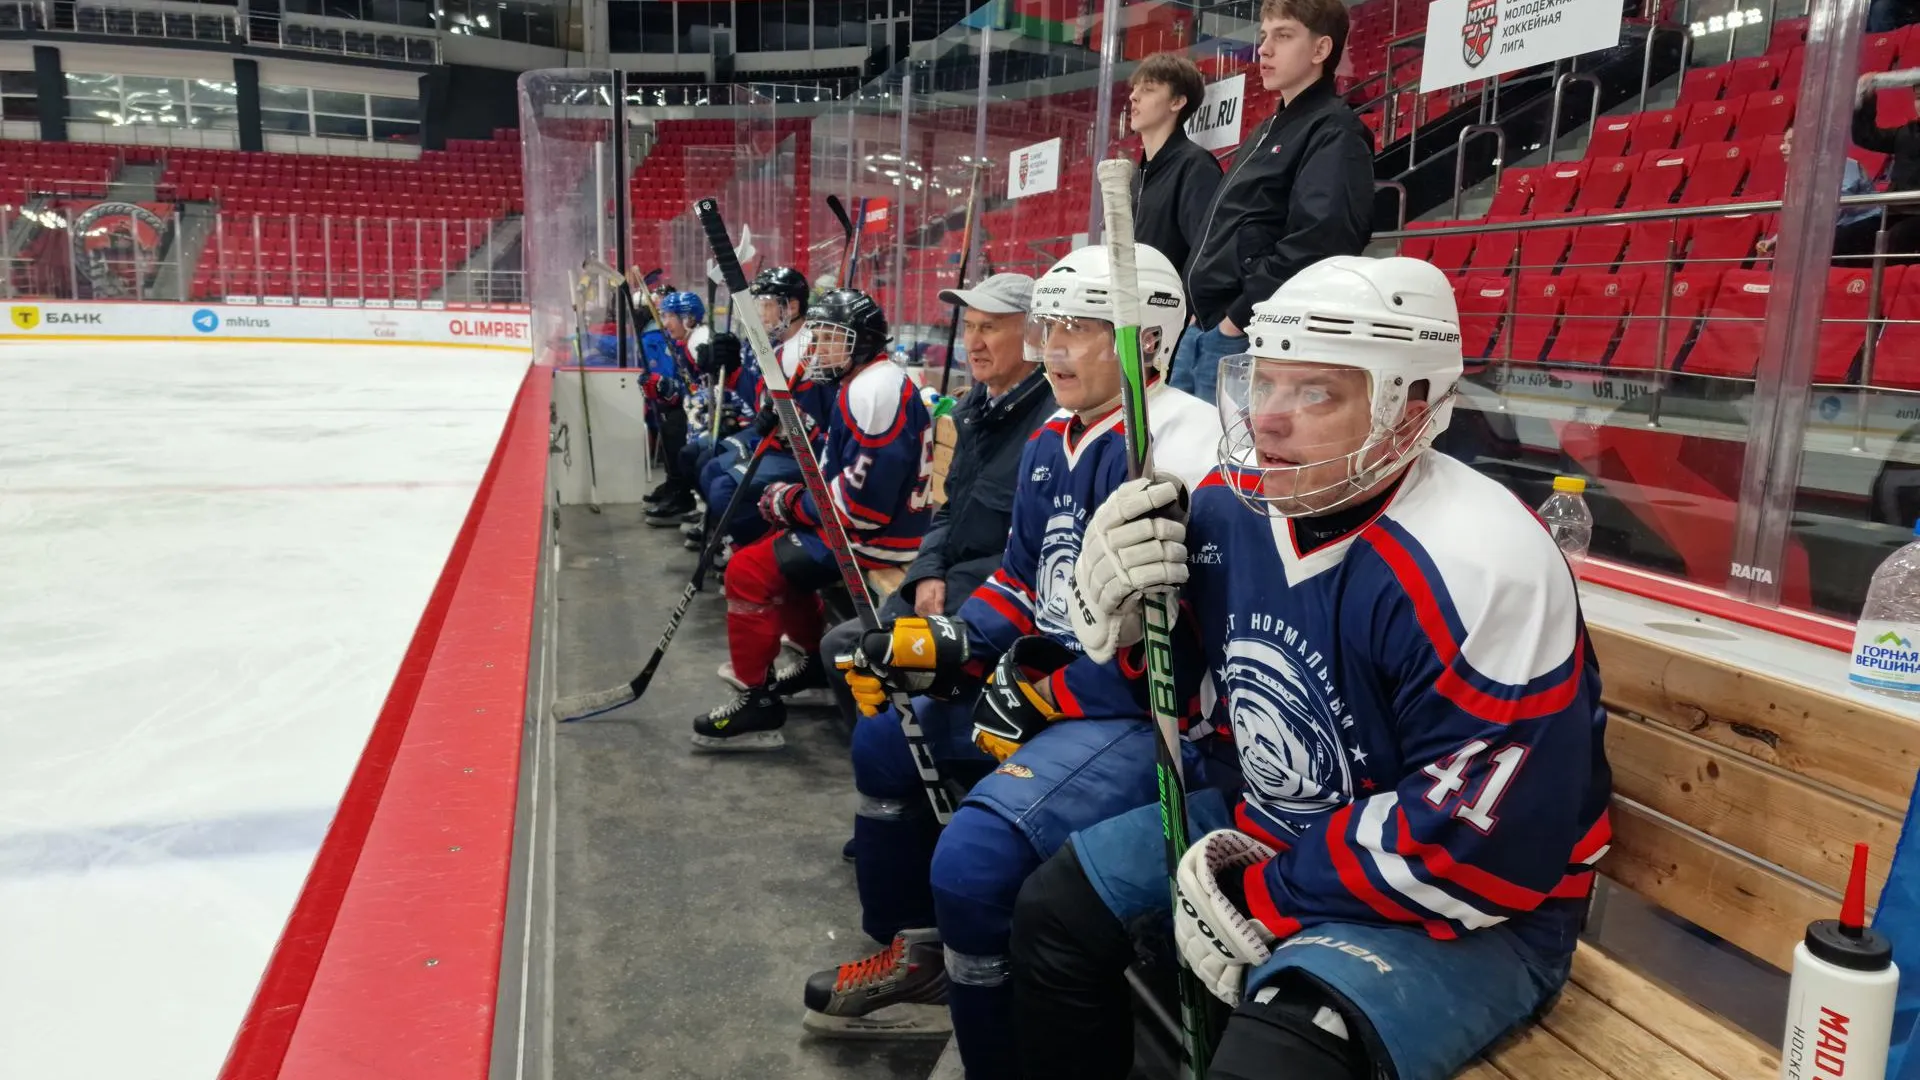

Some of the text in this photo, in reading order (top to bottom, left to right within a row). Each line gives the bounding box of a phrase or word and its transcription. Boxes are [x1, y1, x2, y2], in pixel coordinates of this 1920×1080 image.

[1468, 4, 1496, 24] МХЛ
[1503, 0, 1573, 21] МОЛОДЕЖ
[1502, 10, 1562, 37] ХОККЕЙНАЯ
[1500, 38, 1525, 55] ЛИГА
[1150, 296, 1178, 306] BAUER
[46, 313, 102, 324] БАНК
[449, 319, 528, 338] OLIMPBET
[1257, 313, 1301, 325] BAUER
[1419, 330, 1460, 343] BAUER
[1730, 562, 1773, 585] RAITA
[1863, 644, 1919, 663] ГОРНАЯ
[1421, 739, 1531, 836] 41
[1157, 763, 1171, 841] BAUER
[1177, 884, 1236, 959] OOD
[1815, 1005, 1850, 1077] MAD
